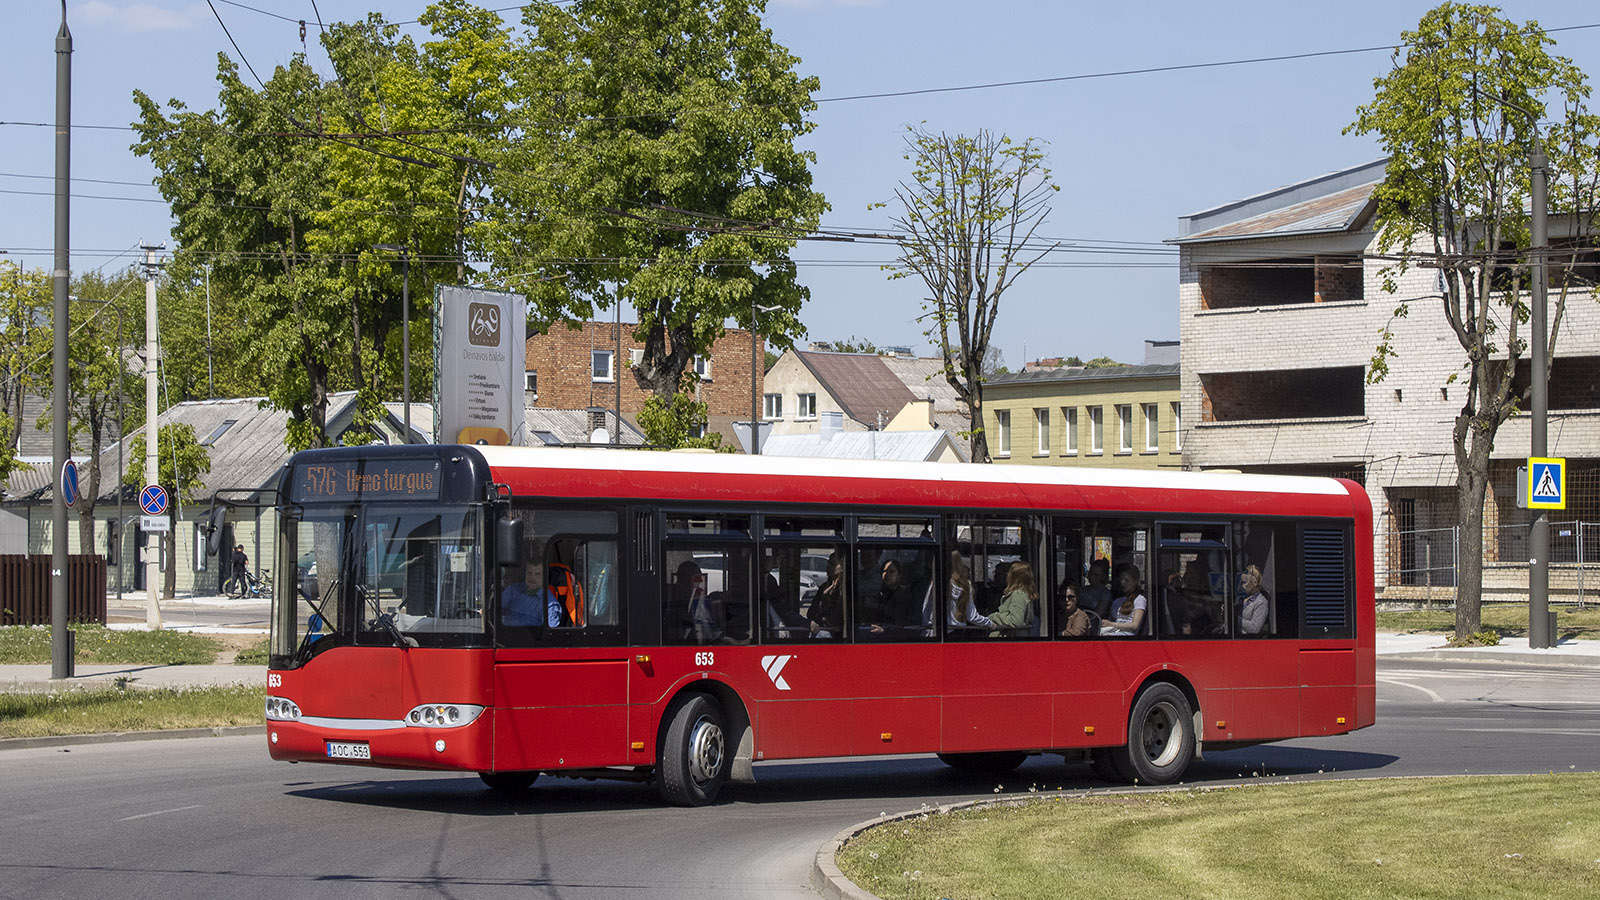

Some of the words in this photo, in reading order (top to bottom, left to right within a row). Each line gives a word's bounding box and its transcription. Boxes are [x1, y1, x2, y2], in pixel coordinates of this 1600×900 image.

[307, 466, 336, 496] 57G
[383, 468, 433, 494] turgus
[694, 652, 714, 666] 653
[268, 674, 281, 687] 653
[353, 746, 369, 757] 553
